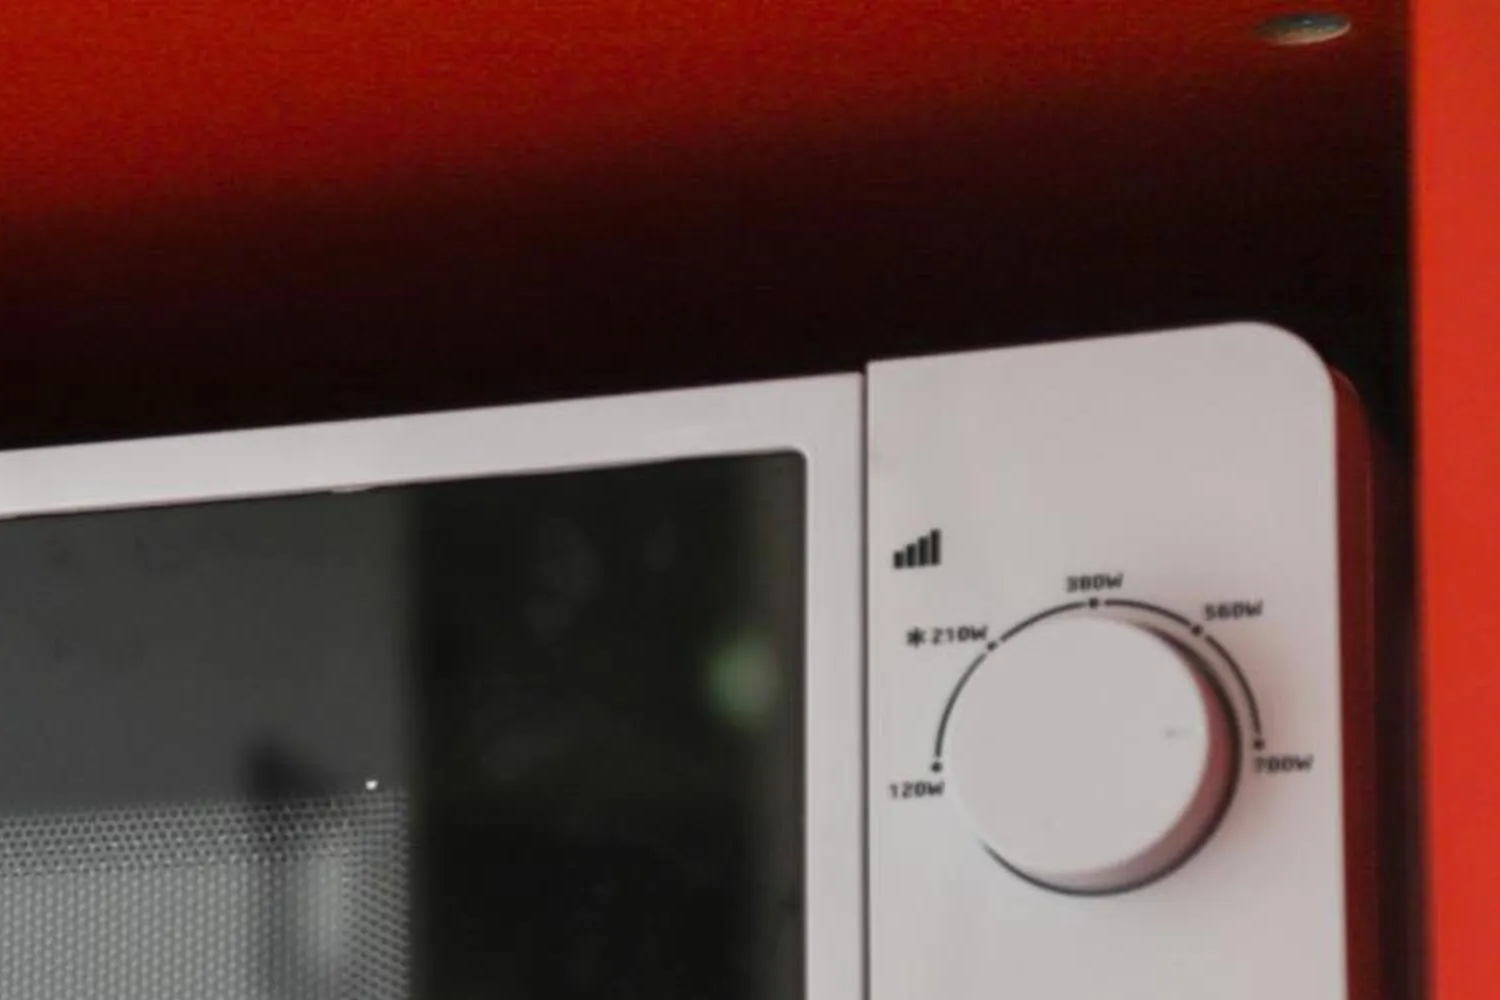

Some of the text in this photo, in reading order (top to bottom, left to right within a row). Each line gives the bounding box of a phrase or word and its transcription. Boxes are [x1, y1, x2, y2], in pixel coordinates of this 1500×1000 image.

[1204, 600, 1263, 621] 560W
[931, 625, 988, 646] 210W
[889, 780, 945, 800] 120W
